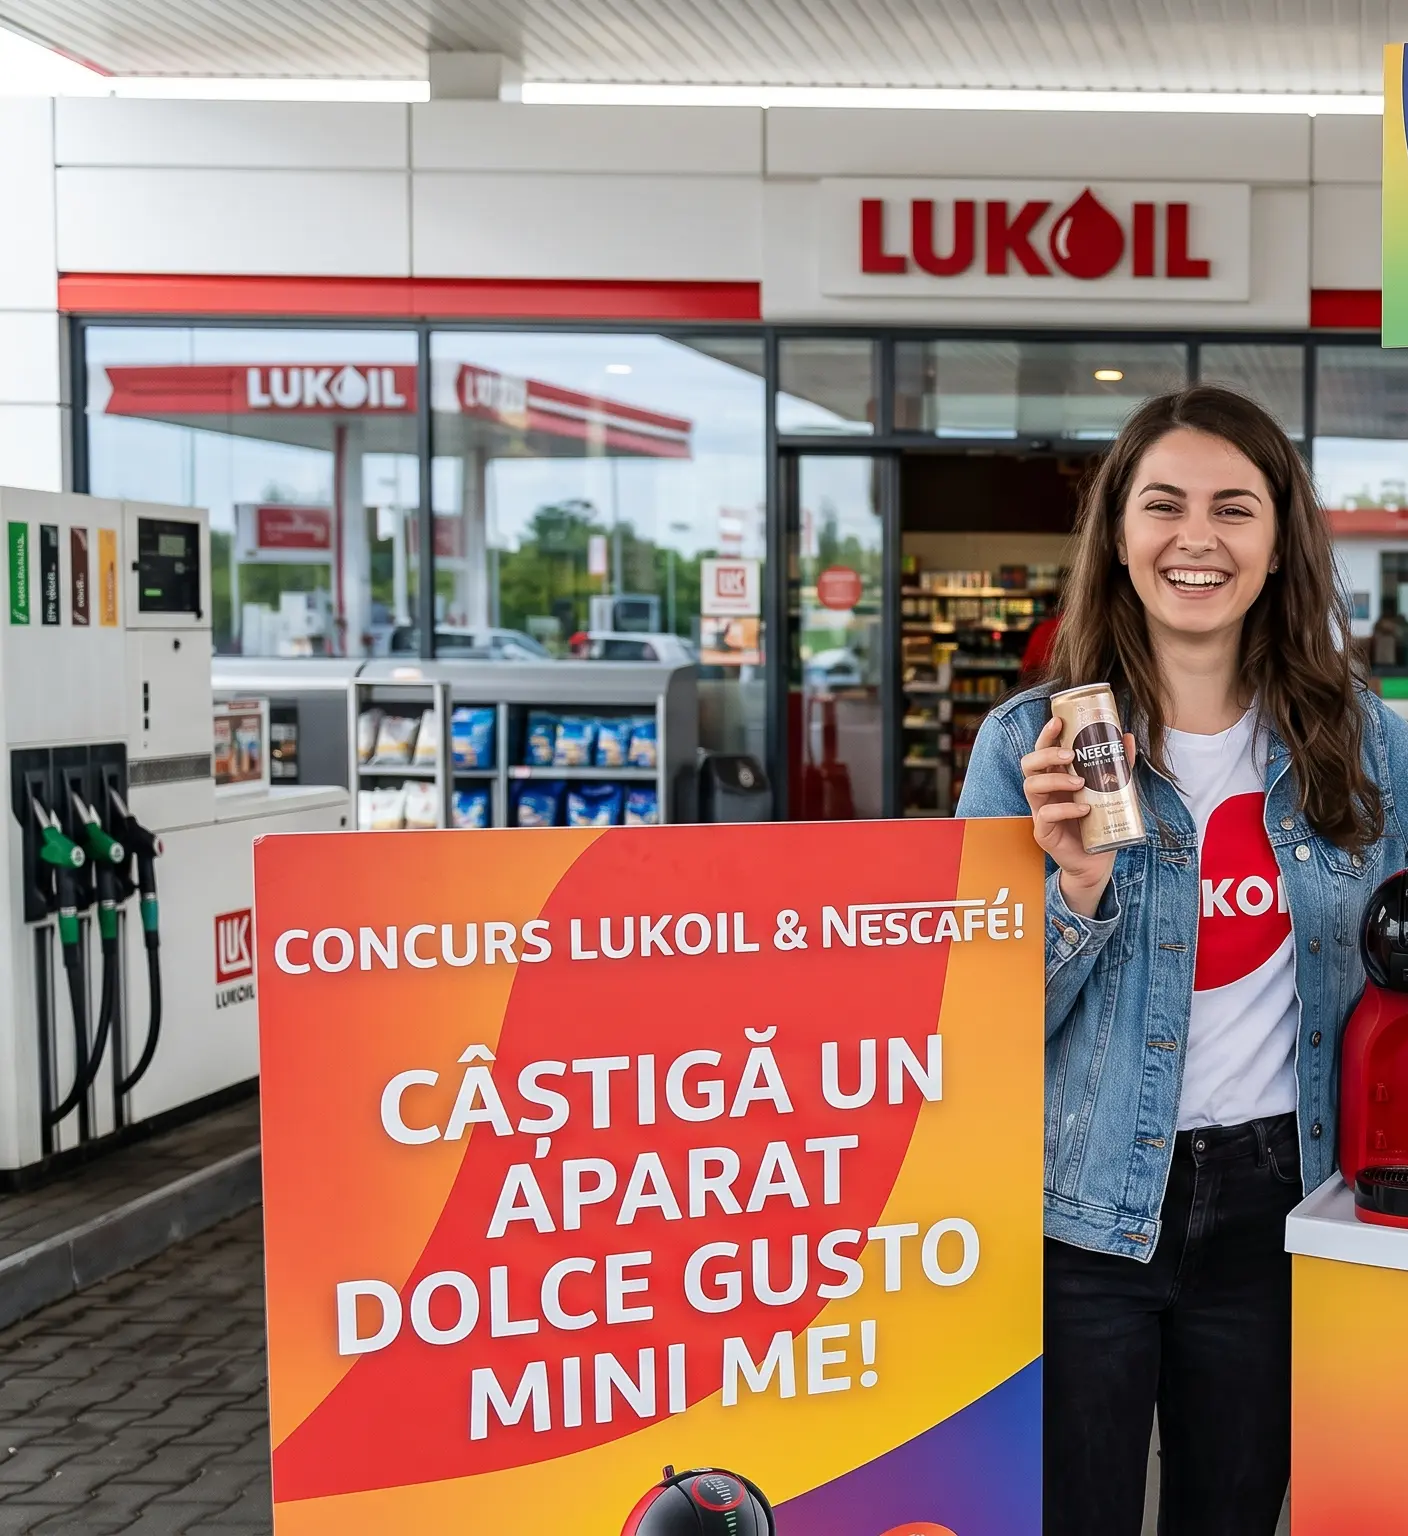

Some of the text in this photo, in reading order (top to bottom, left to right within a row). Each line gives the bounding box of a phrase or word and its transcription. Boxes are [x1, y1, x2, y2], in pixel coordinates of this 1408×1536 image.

[860, 186, 1211, 280] LUKOIL
[273, 886, 1025, 975] CONCURS LUKOIL & NESCAFÉ!
[379, 1025, 944, 1160] CÂȘTIGĂ UN
[485, 1133, 860, 1240] APARAT
[335, 1216, 981, 1357] DOLCE GUSTO
[469, 1318, 879, 1442] MINI ME!
